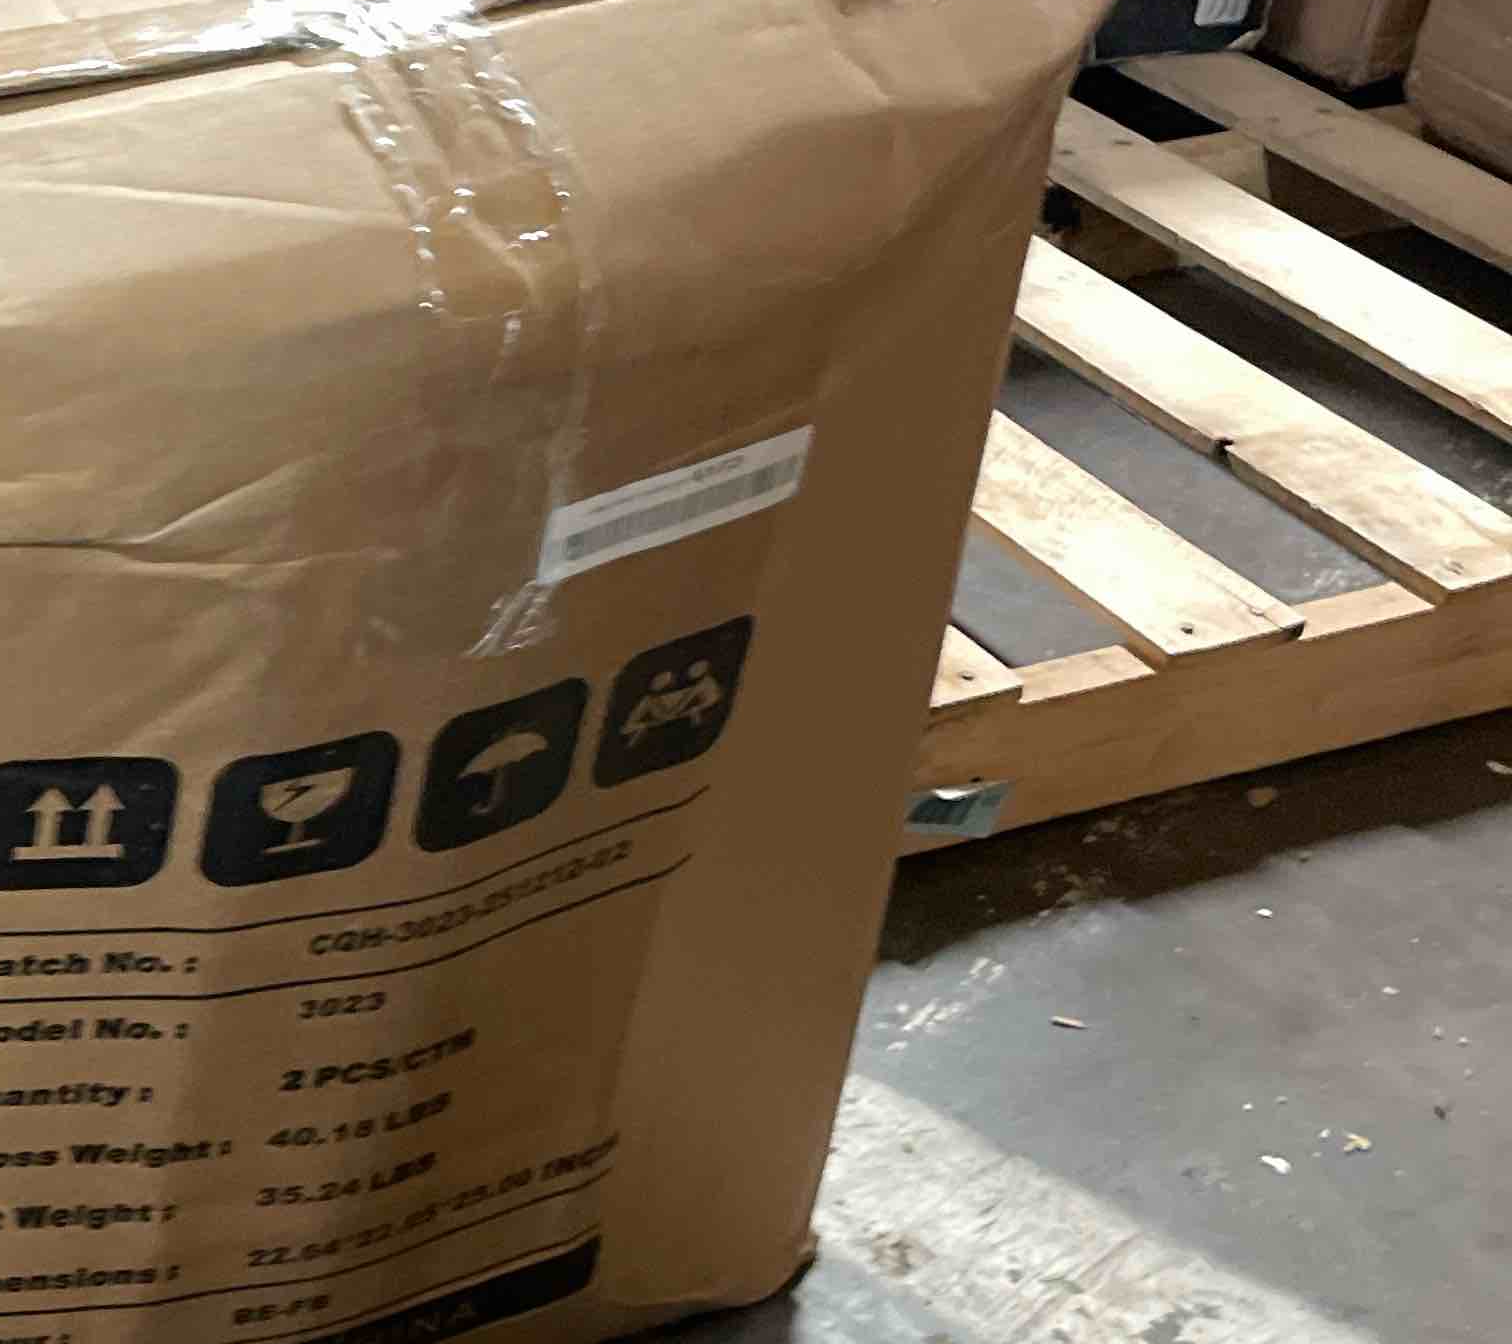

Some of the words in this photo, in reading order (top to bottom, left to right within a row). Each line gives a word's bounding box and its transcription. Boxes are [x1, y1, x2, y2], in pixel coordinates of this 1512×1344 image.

[103, 952, 173, 974] No.
[94, 1017, 164, 1040] No.
[298, 991, 387, 1020] 3023
[278, 1069, 306, 1091] 2
[67, 1140, 212, 1168] Weight
[382, 1091, 453, 1132] LBS
[13, 1205, 153, 1230] Weight
[368, 1152, 437, 1193] LBS
